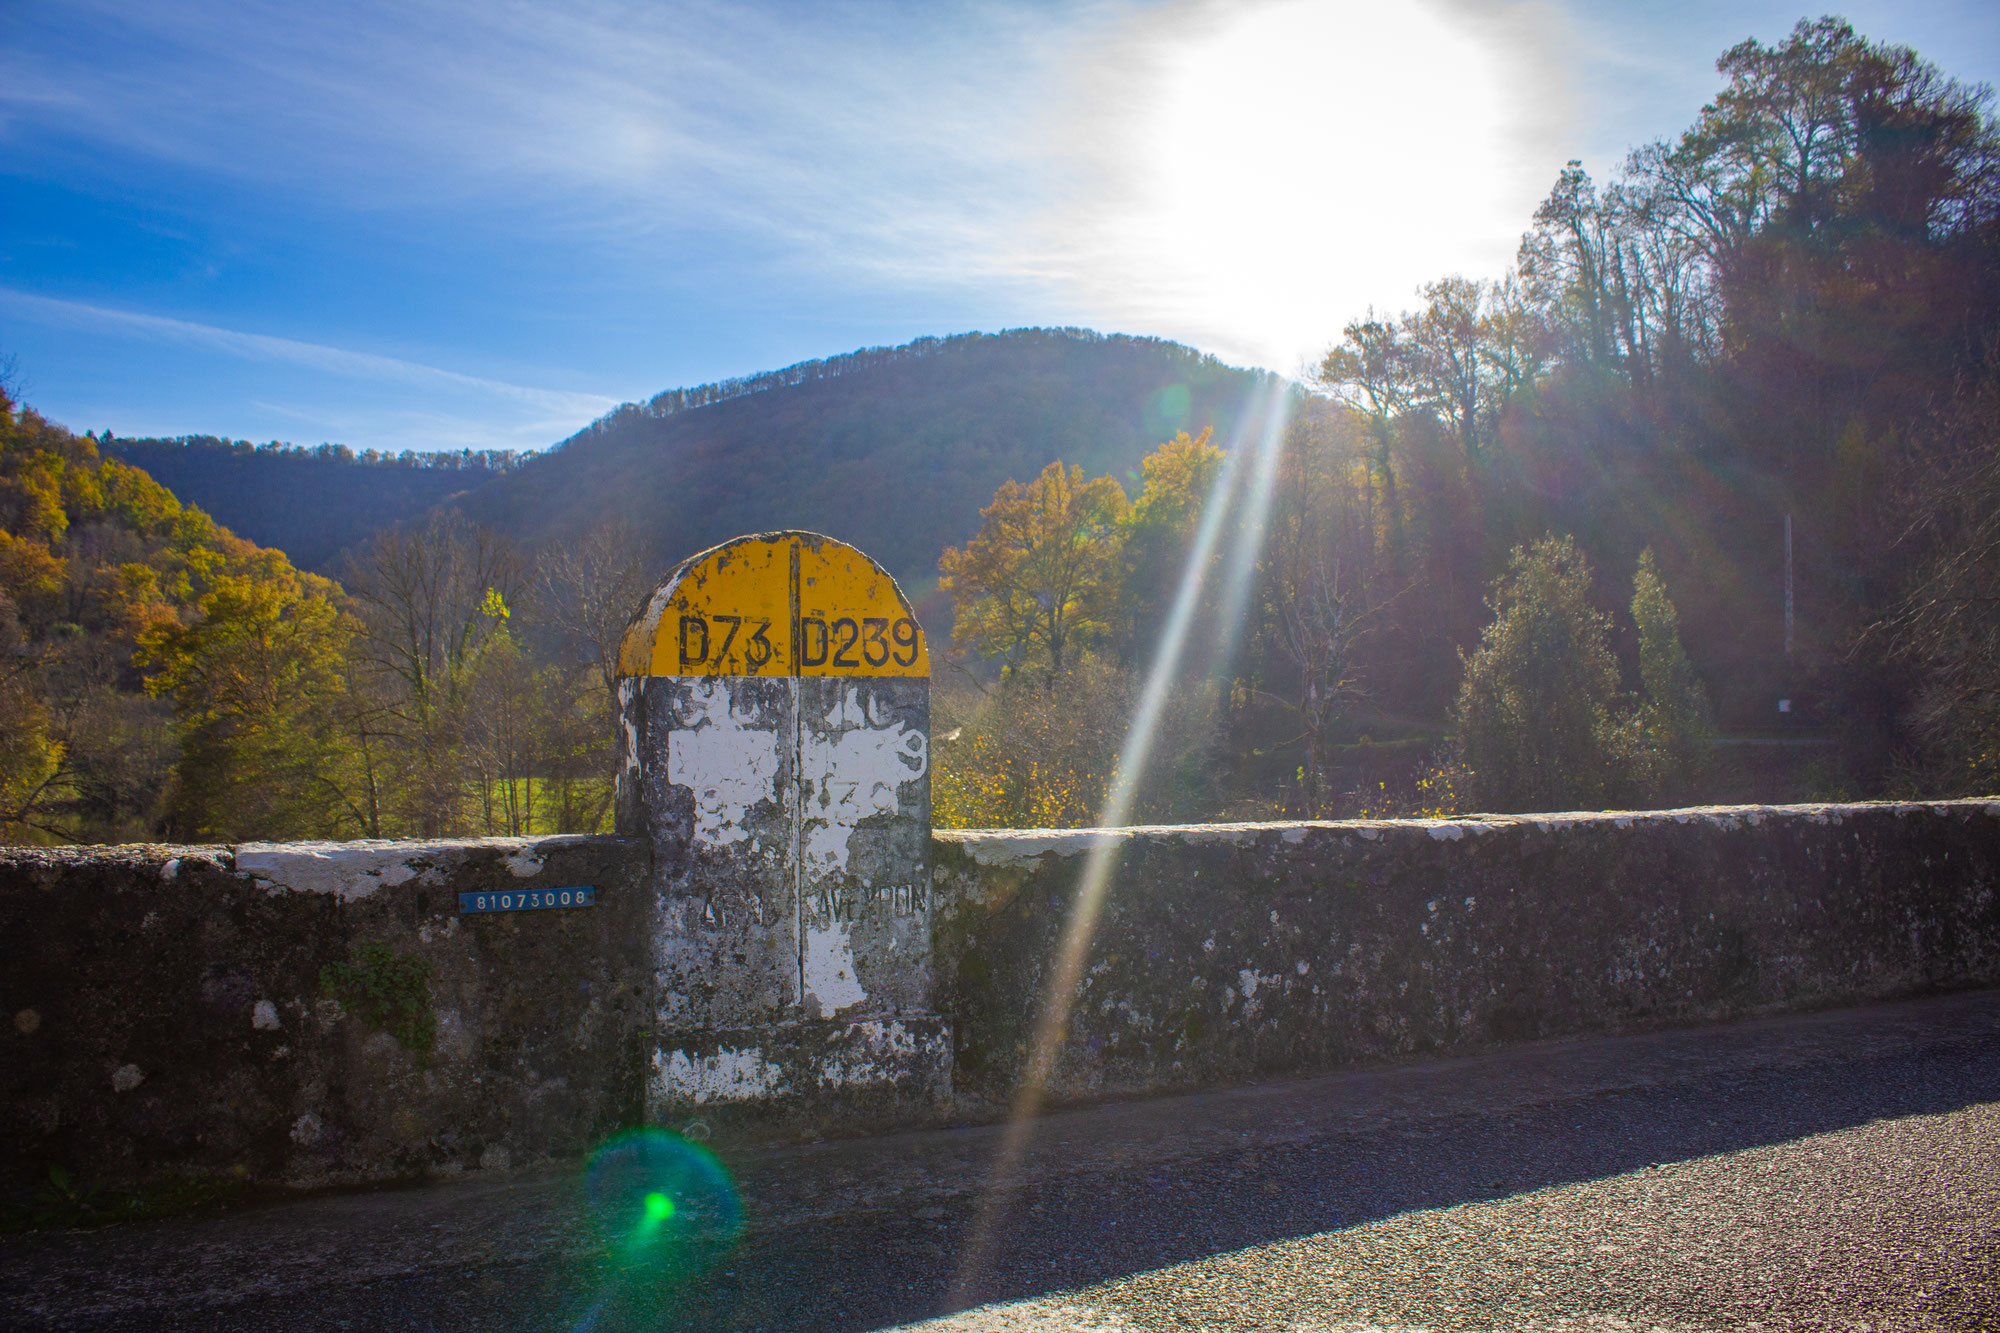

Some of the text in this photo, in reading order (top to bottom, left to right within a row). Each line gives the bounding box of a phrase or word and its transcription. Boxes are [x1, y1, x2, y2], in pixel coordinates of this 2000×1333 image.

[679, 615, 772, 667] D73
[800, 617, 918, 667] D239
[477, 891, 584, 910] 81073008
